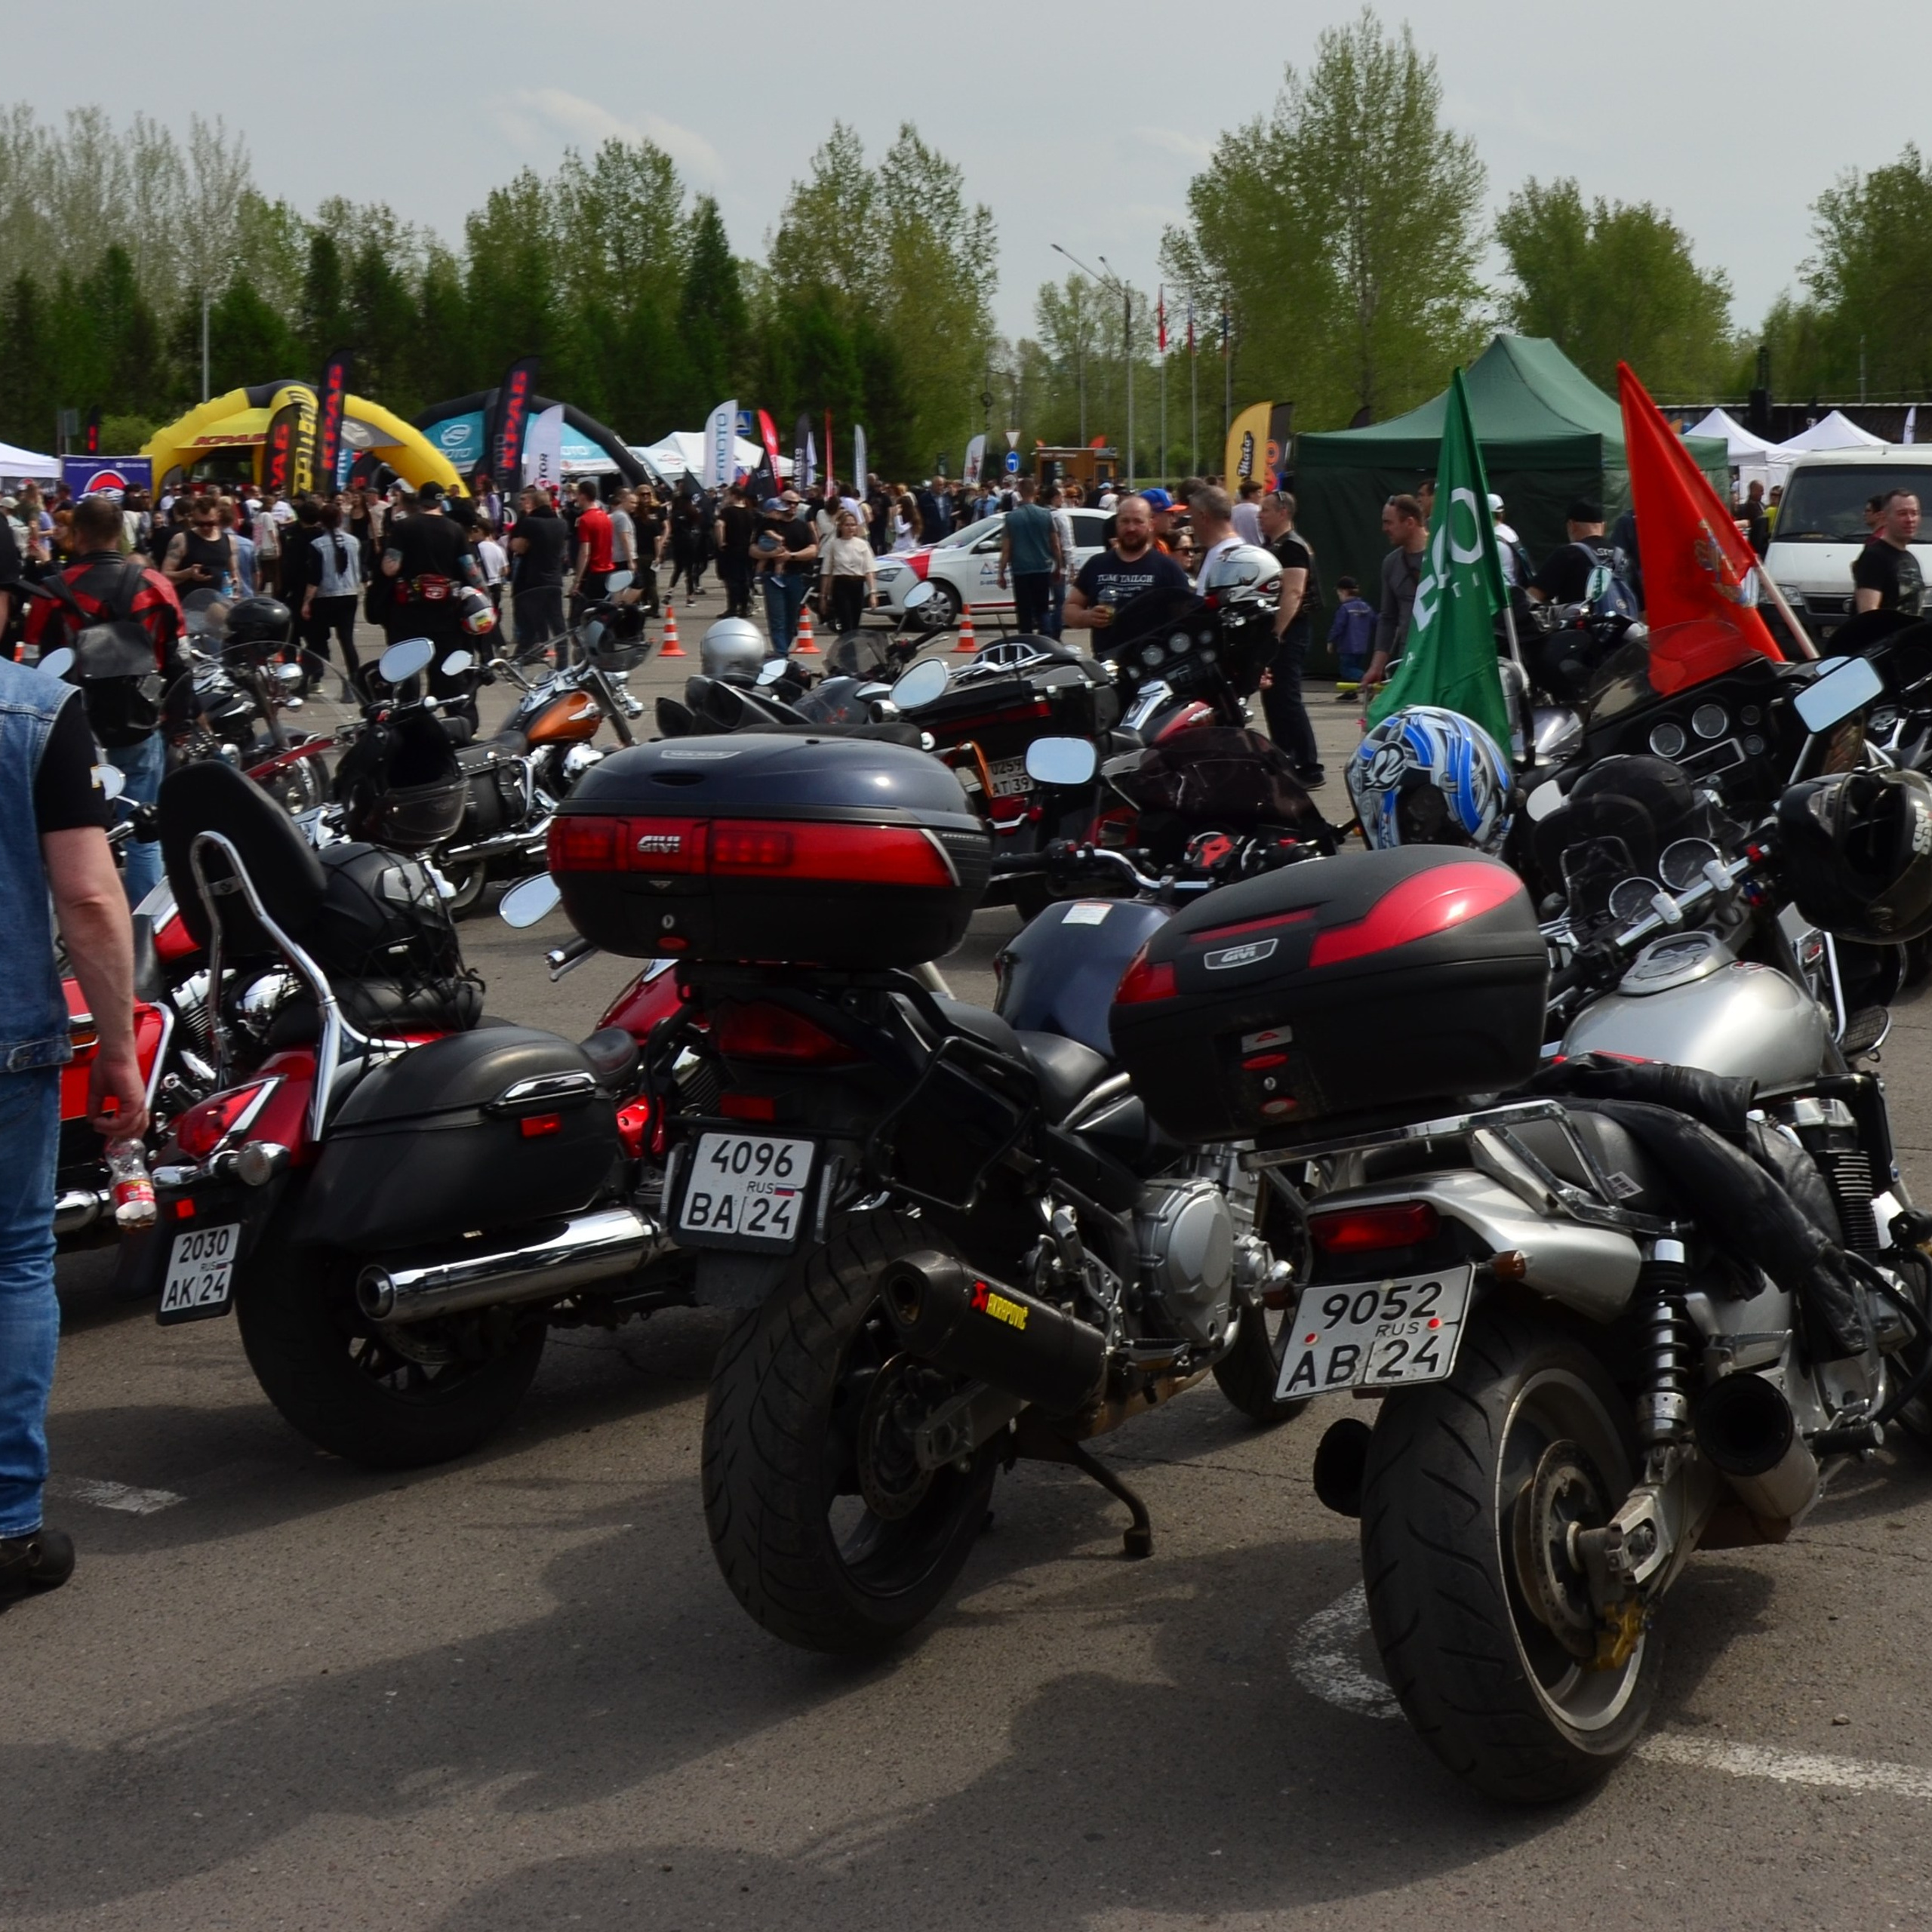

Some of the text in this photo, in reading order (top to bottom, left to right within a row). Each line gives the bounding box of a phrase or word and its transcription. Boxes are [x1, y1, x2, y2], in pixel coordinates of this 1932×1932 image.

[1012, 777, 1029, 792] 39
[637, 835, 681, 854] GIVI
[1221, 946, 1257, 963] GIVI
[711, 1140, 793, 1177] 4096
[746, 1181, 774, 1194] RUS
[747, 1198, 791, 1234] 24
[179, 1229, 229, 1263] 2030
[199, 1272, 225, 1301] 24
[1323, 1281, 1442, 1330] 9052
[1375, 1322, 1420, 1337] RUS
[1377, 1335, 1438, 1377] 24
